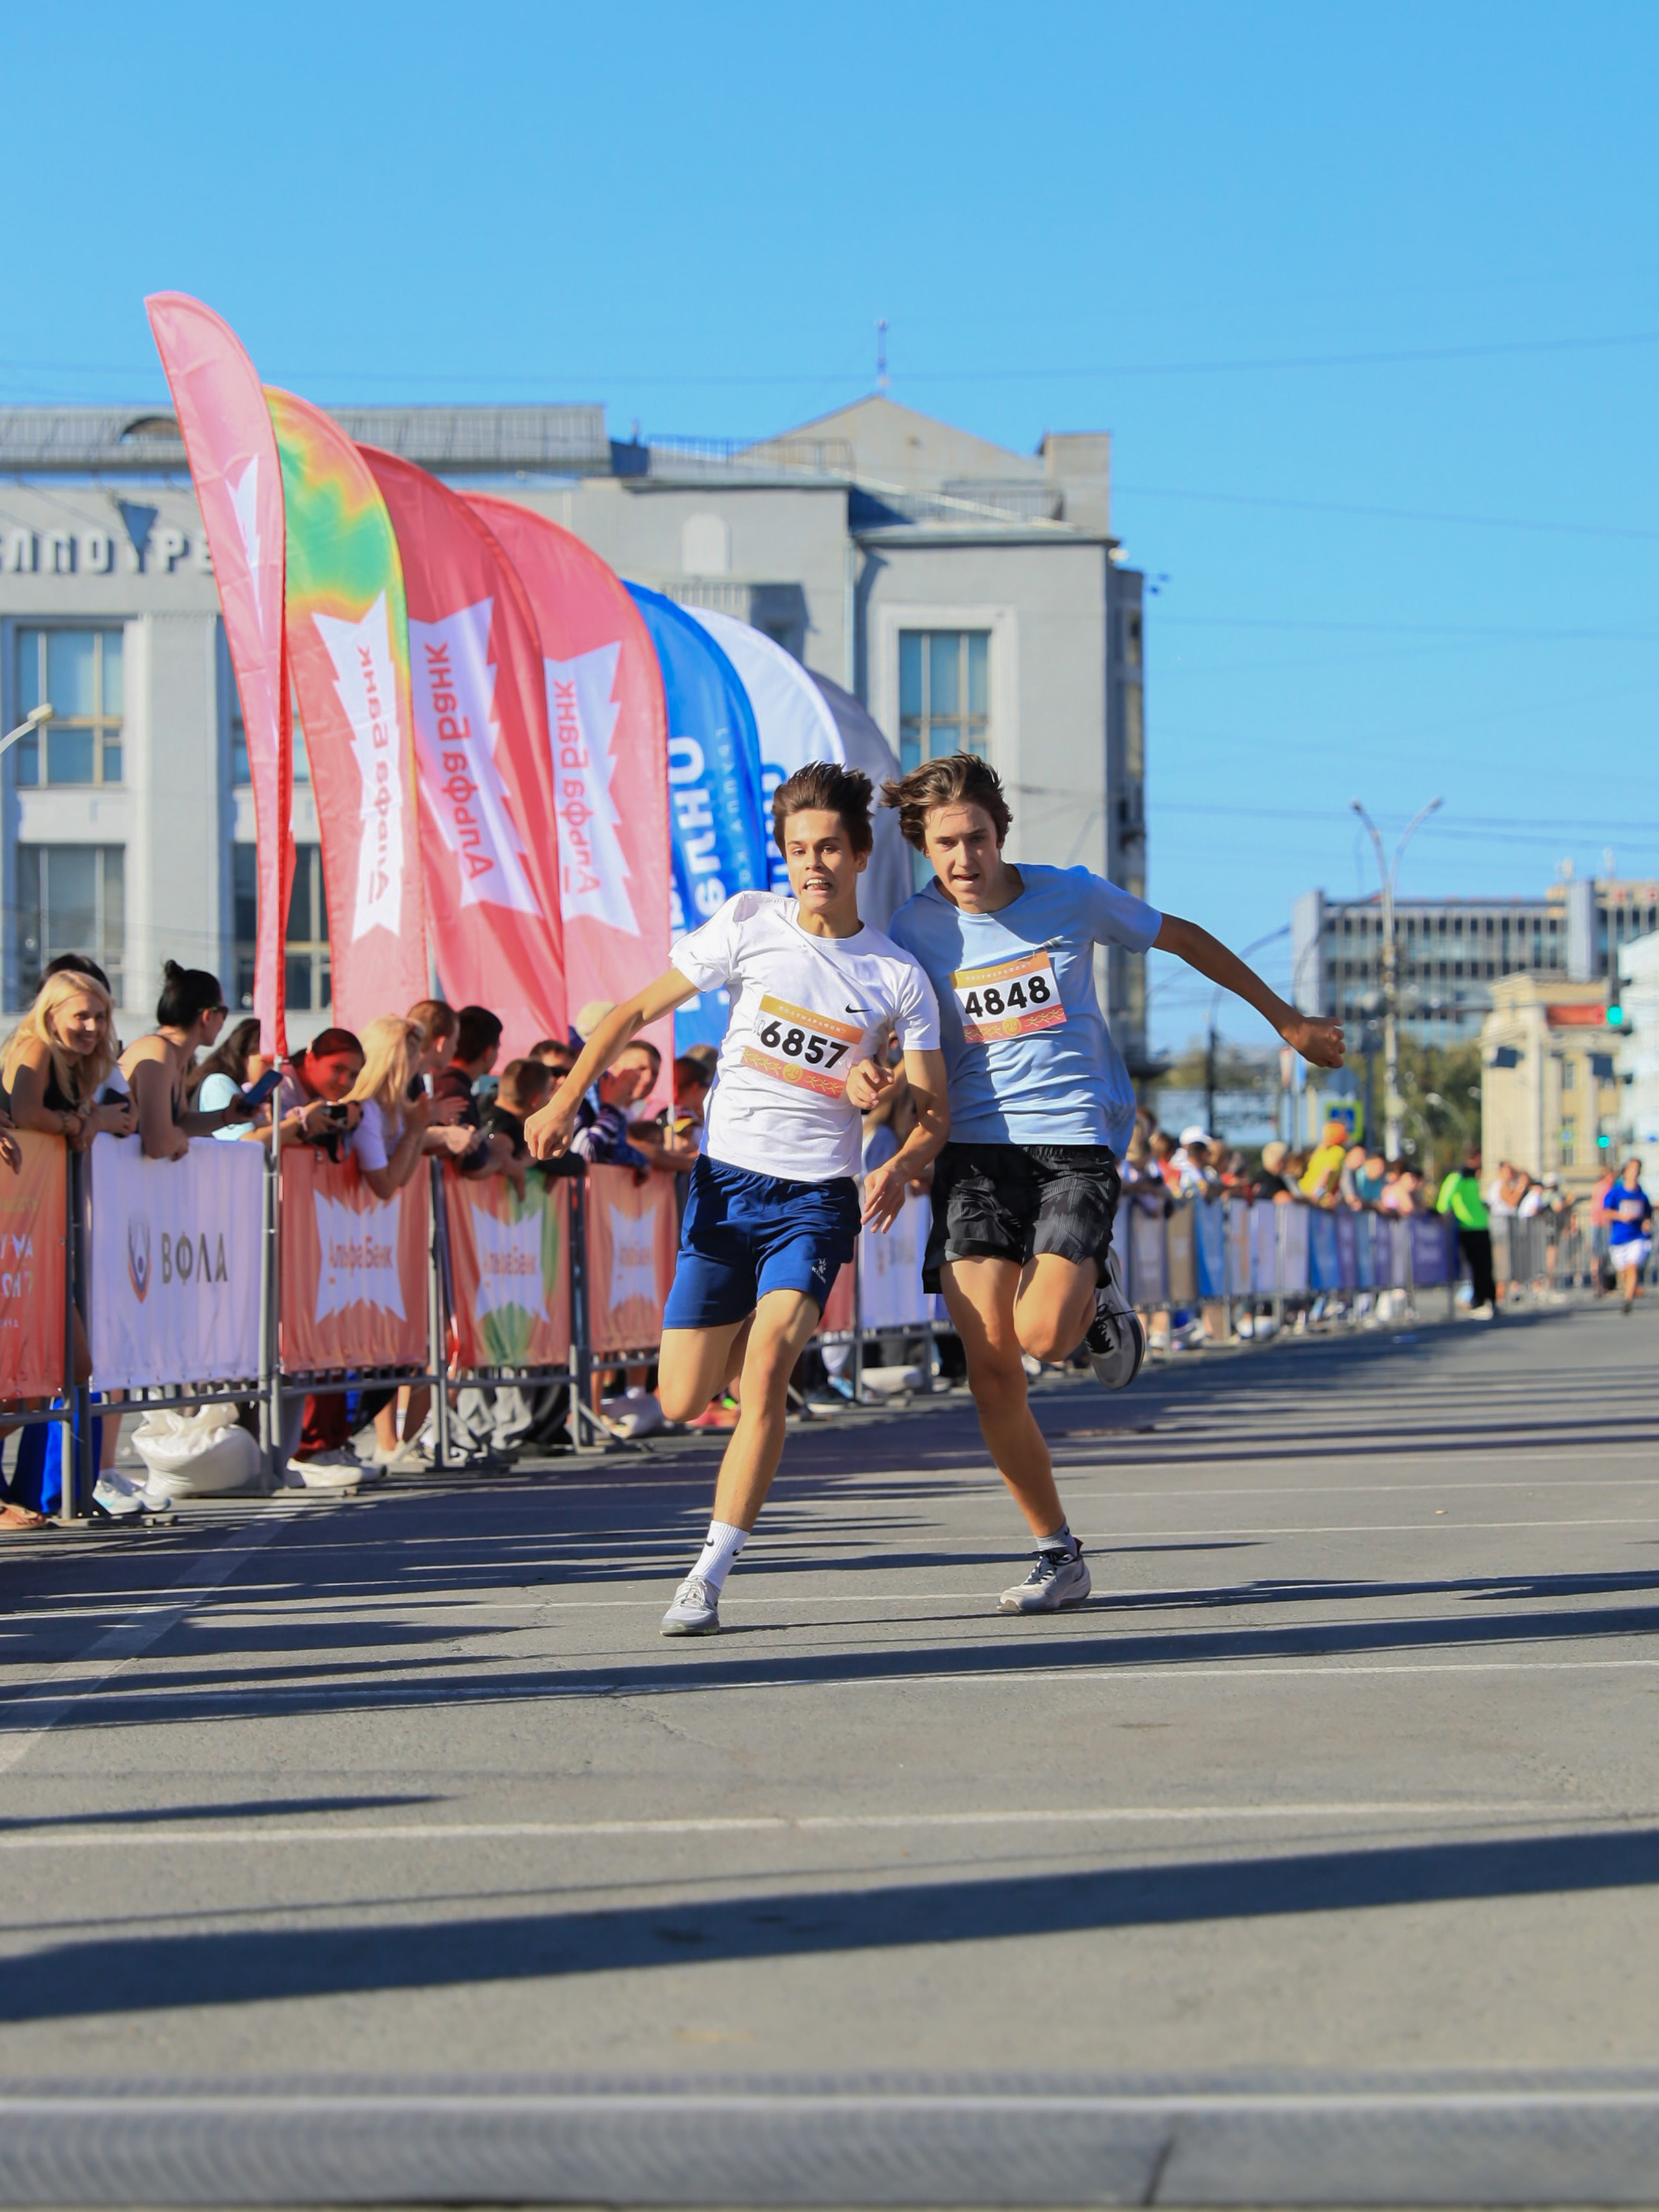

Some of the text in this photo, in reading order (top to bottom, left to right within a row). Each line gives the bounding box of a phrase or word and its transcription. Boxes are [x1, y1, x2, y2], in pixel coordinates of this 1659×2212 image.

[965, 976, 1050, 1017] 4848
[761, 1021, 850, 1069] 6857
[162, 1230, 228, 1285] ВФЛА
